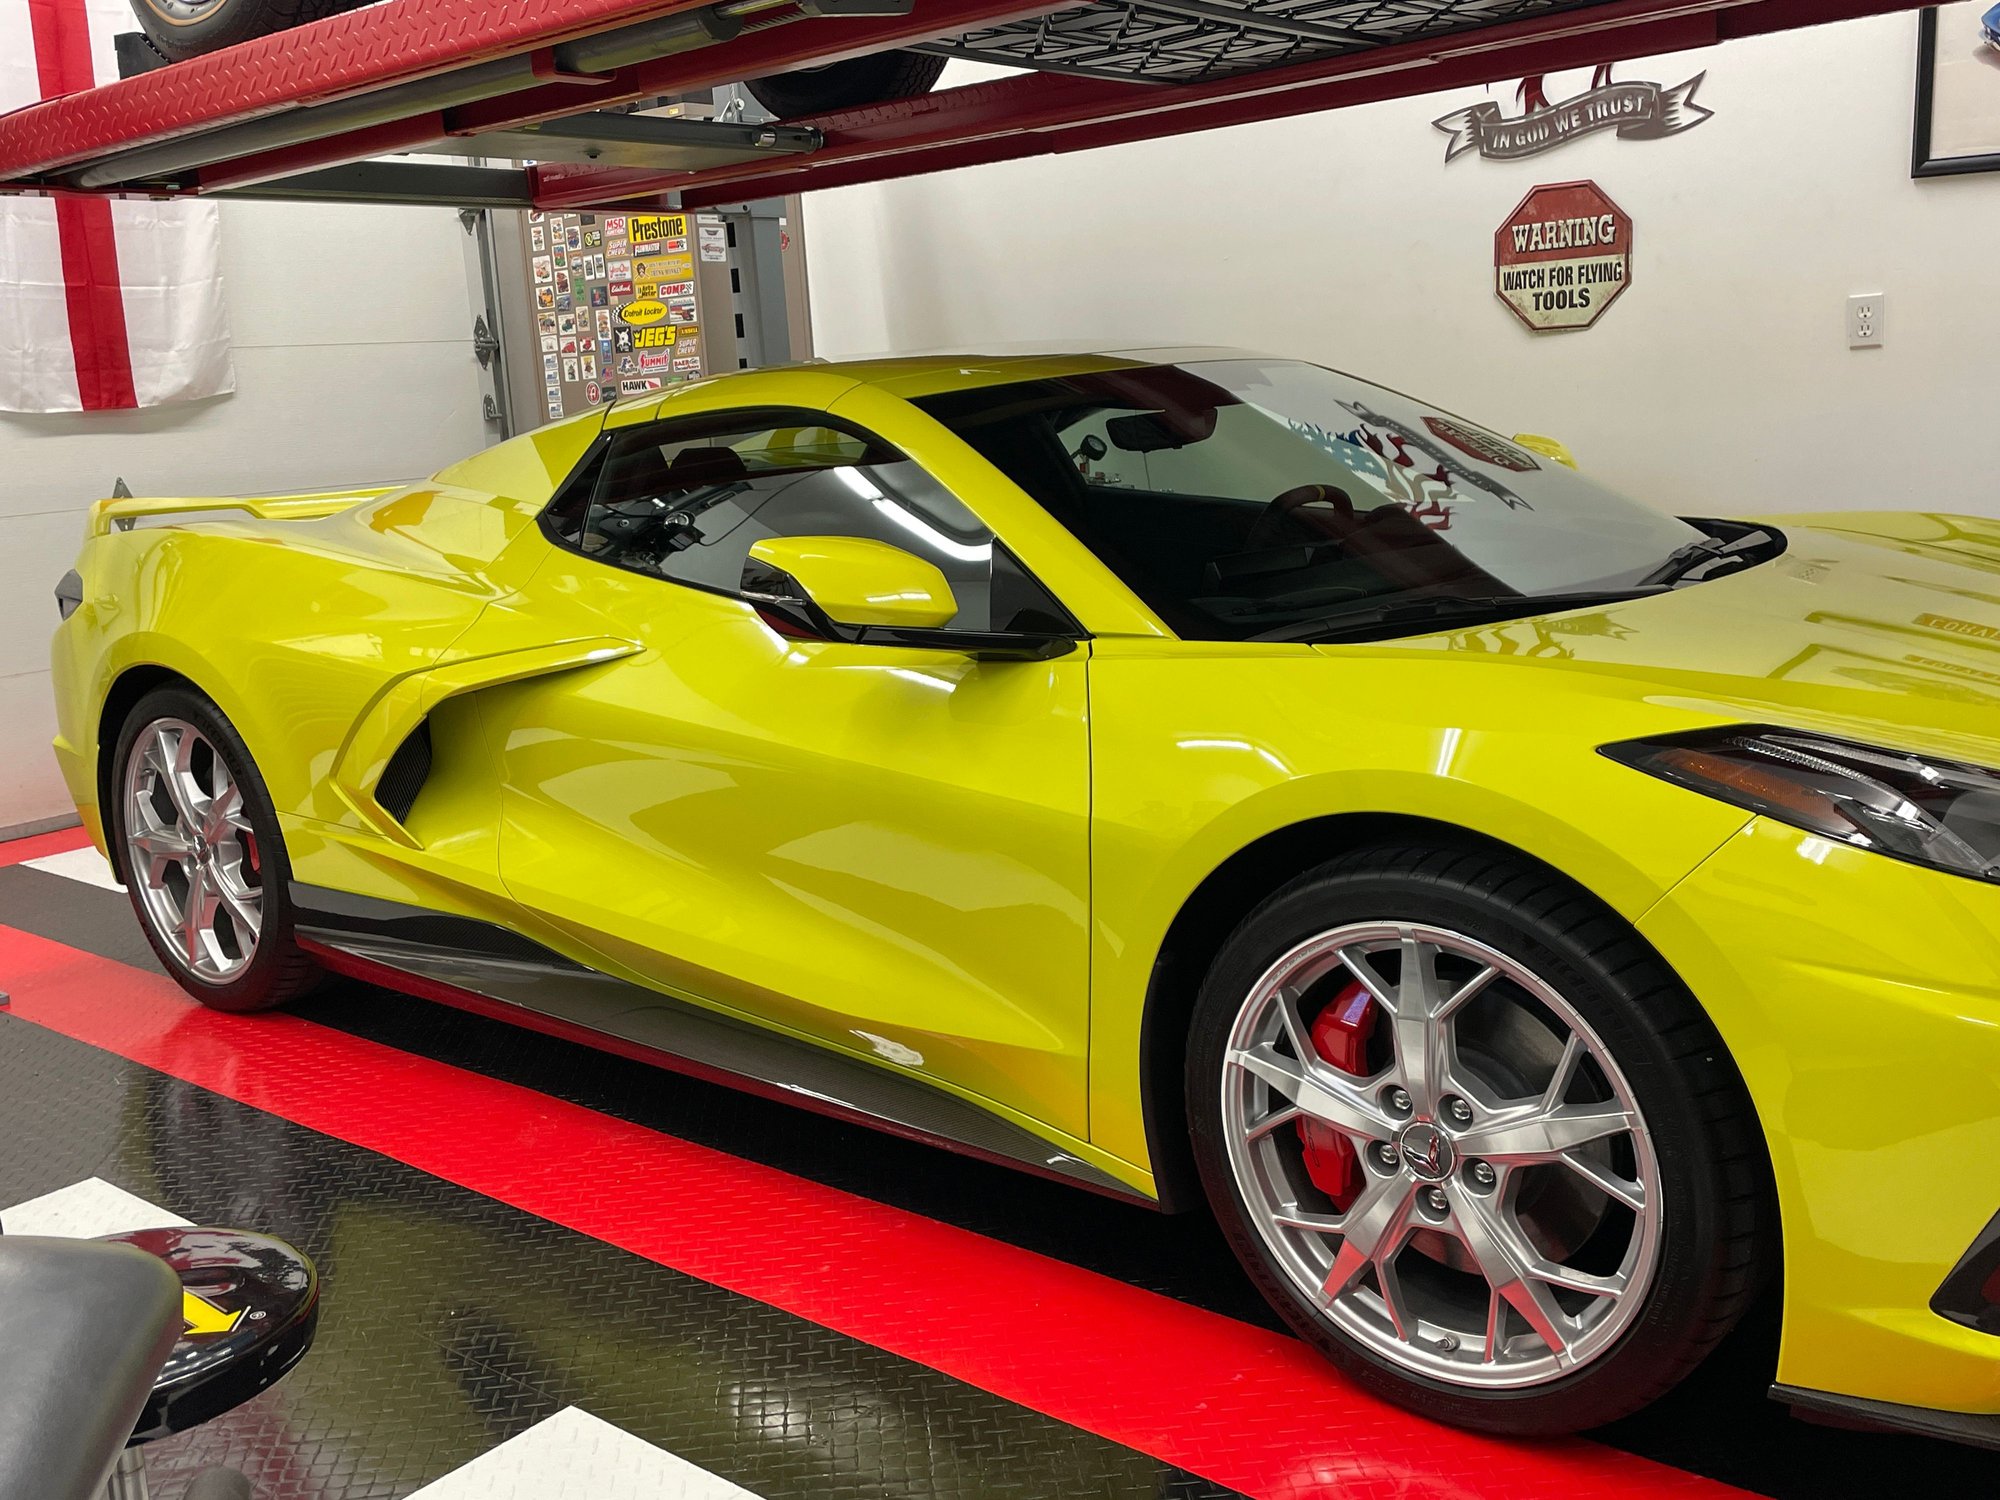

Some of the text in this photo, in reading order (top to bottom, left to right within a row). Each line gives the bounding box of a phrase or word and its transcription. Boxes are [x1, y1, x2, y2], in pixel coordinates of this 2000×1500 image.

[1493, 96, 1645, 150] IN GOD WE TRUST
[606, 218, 624, 229] MSD
[632, 217, 683, 241] Prestone
[1511, 213, 1616, 254] WARNING
[608, 240, 627, 249] SUPER
[607, 247, 626, 257] CHEVY
[1503, 261, 1623, 292] WATCH FOR FLYING
[660, 283, 686, 296] COMP
[1532, 287, 1591, 312] TOOLS
[624, 307, 663, 318] Detroit Locker
[634, 326, 676, 348] JEG'S
[678, 338, 697, 348] SUPER
[677, 346, 696, 355] CHEVY
[641, 353, 668, 368] SUMMIT
[622, 380, 648, 391] HAWK
